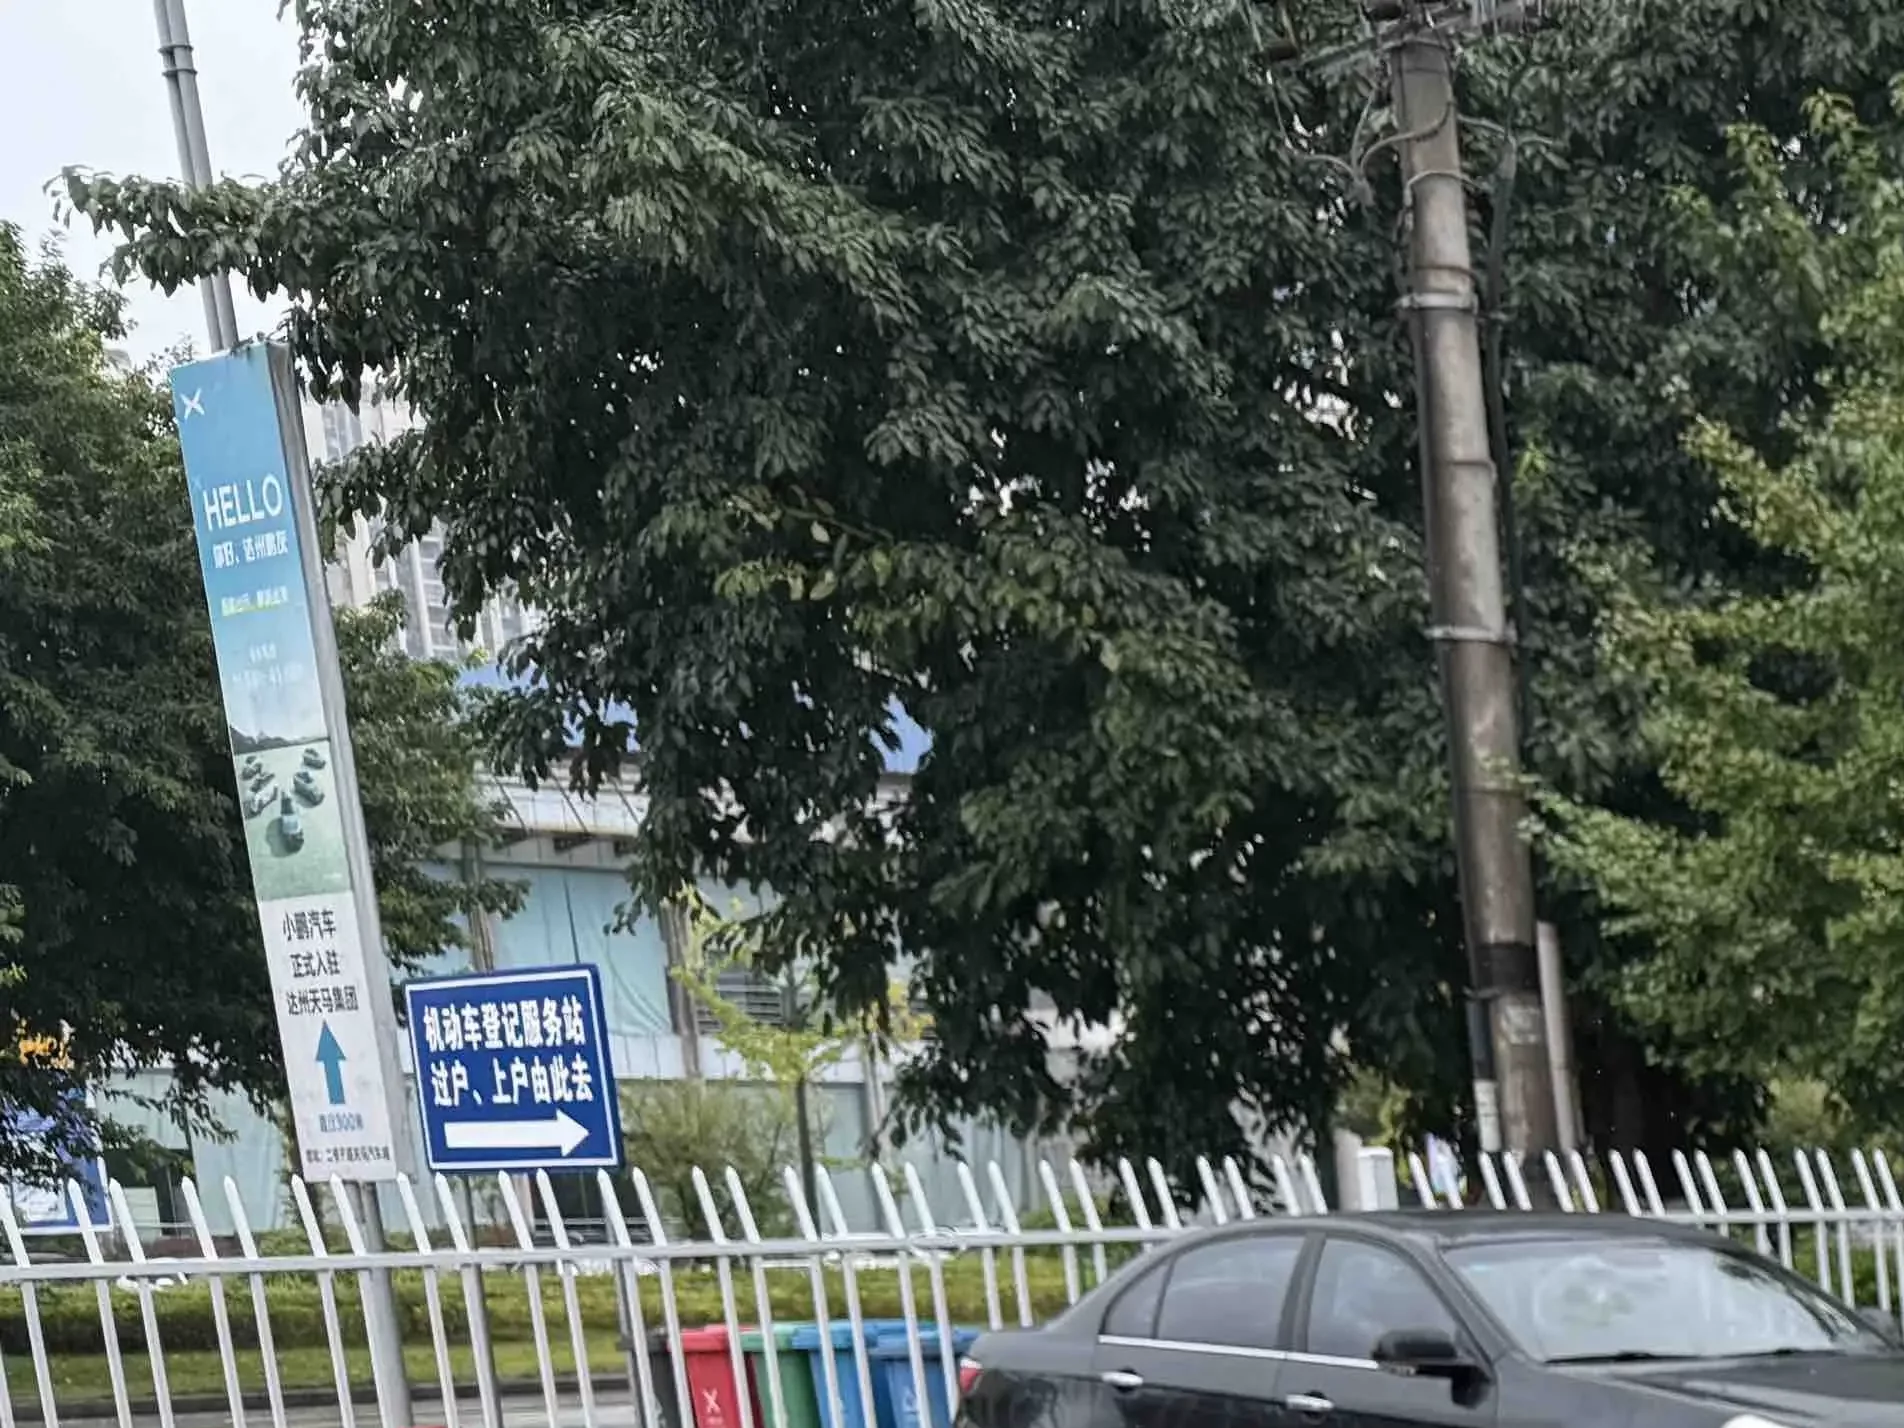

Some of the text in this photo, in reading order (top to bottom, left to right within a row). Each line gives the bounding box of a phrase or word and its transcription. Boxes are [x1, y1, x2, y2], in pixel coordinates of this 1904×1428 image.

[203, 473, 284, 532] HELLO
[282, 909, 338, 942] 小鹏汽车
[290, 949, 341, 979] 正式入驻
[286, 984, 359, 1016] 达州天马集团
[423, 994, 586, 1053] 机动车登记服务站
[430, 1052, 594, 1107] 过户、上户由此去
